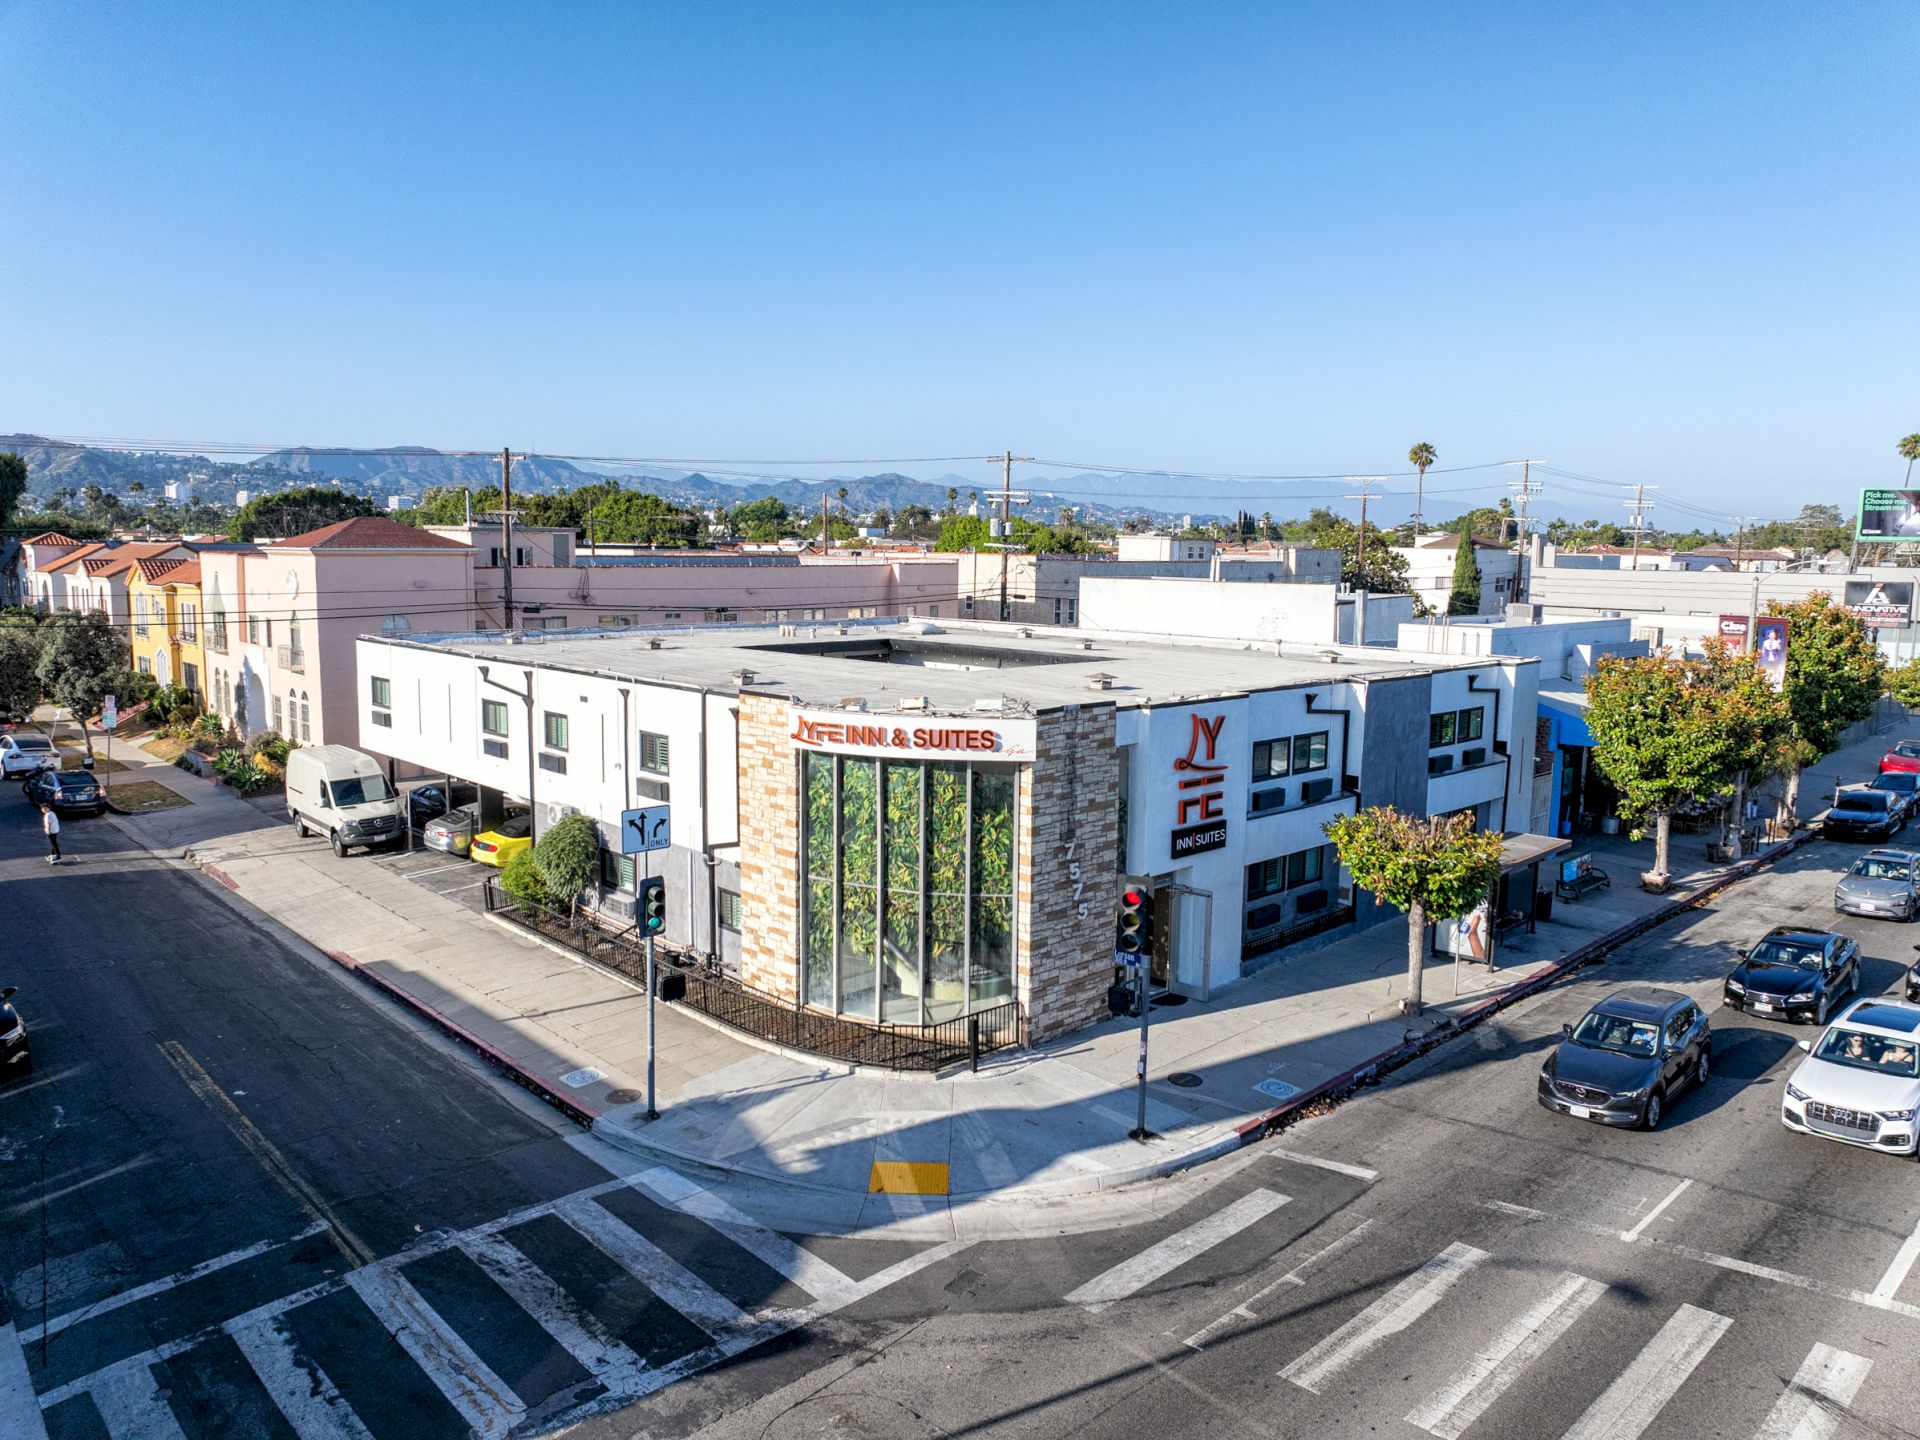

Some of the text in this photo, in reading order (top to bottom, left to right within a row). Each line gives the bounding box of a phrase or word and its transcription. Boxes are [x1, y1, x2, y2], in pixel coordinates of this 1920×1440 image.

[1865, 491, 1881, 499] Pick
[1721, 621, 1747, 631] Clue
[845, 724, 886, 747] INN
[891, 727, 910, 748] &
[913, 727, 1001, 750] SUITES
[650, 838, 669, 847] ONLY
[1195, 828, 1226, 847] SUITES
